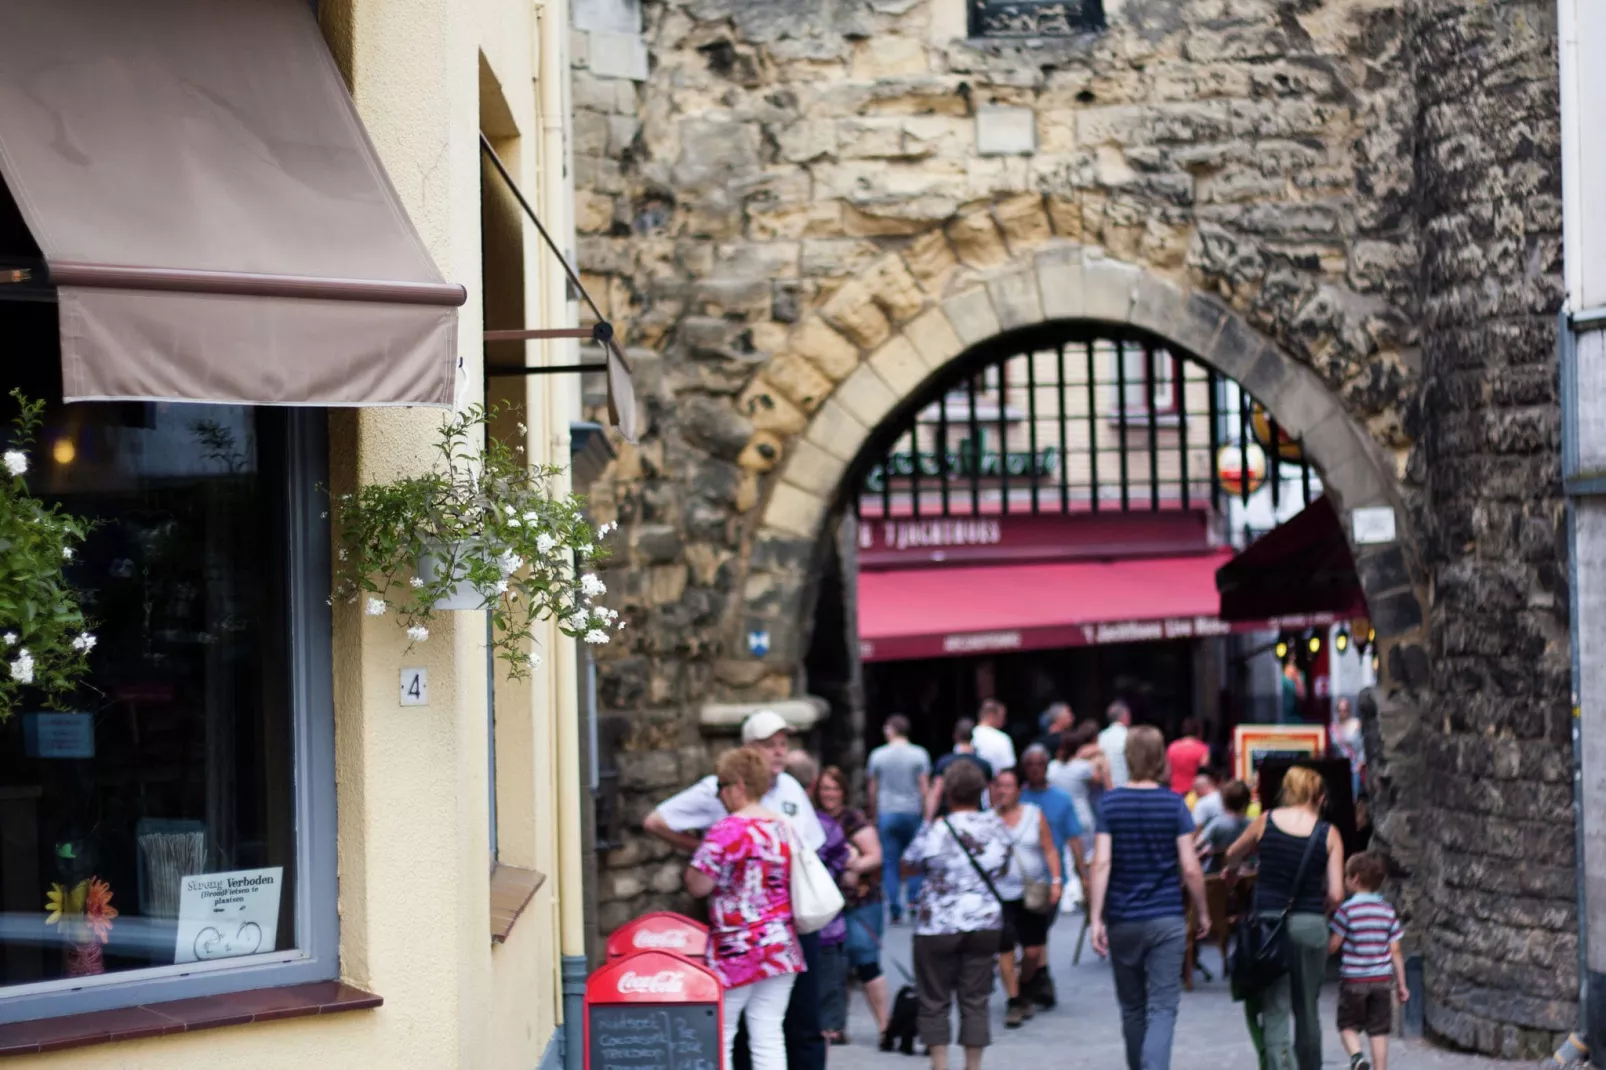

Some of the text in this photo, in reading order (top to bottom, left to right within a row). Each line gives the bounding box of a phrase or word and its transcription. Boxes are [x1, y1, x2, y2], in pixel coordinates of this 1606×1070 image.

[408, 673, 420, 700] 4
[227, 875, 274, 888] Verboden
[214, 896, 245, 907] plaatsen
